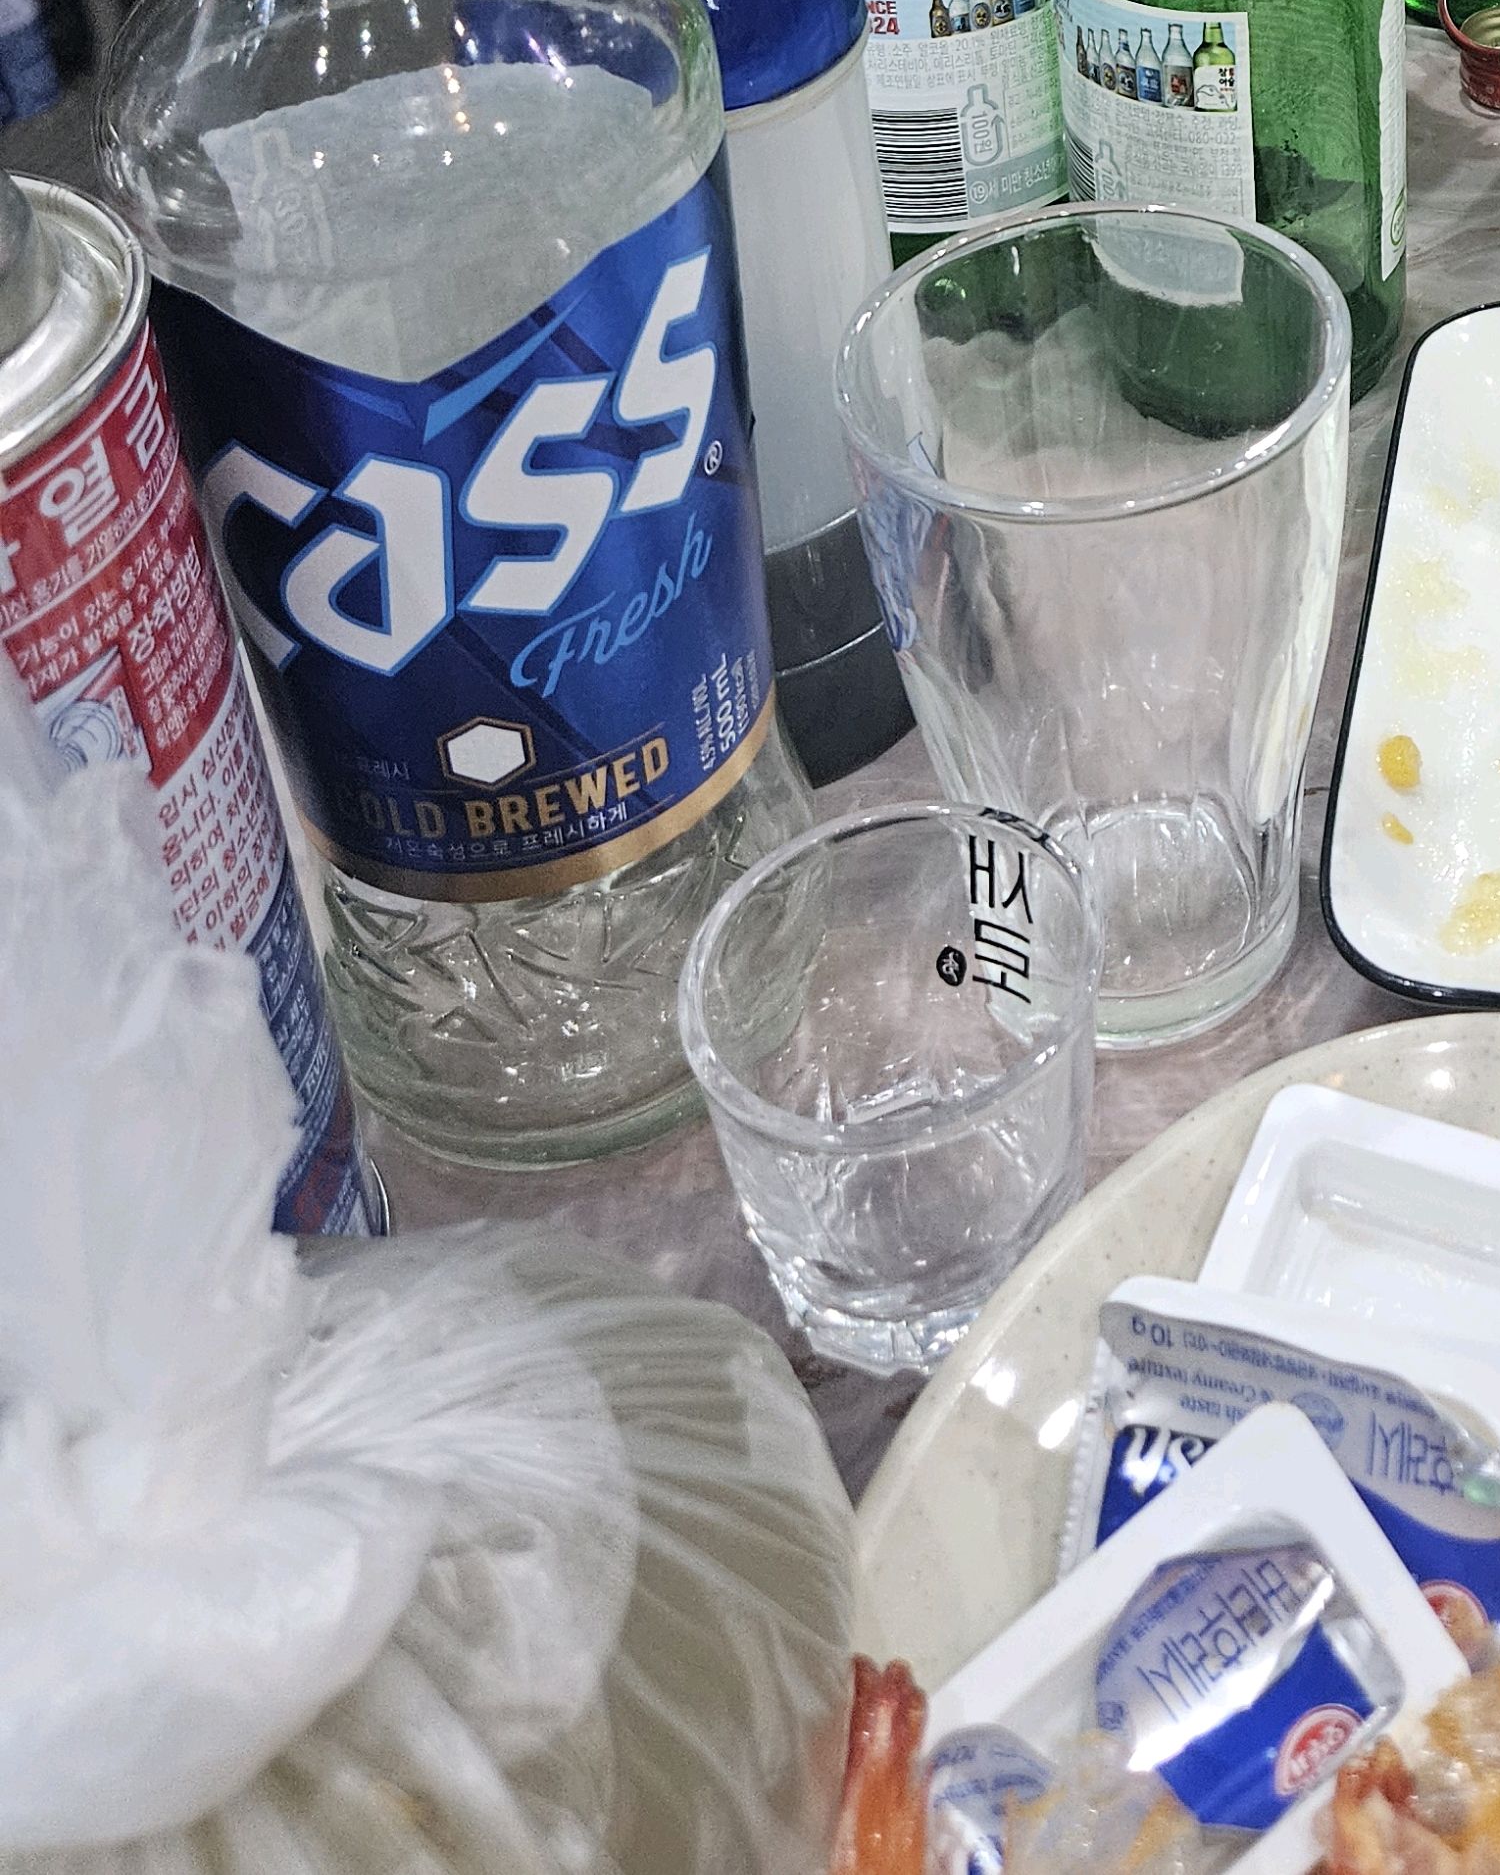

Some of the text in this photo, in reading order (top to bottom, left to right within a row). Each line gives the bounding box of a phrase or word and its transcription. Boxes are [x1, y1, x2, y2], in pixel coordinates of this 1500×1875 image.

[867, 0, 898, 15] NCE
[869, 16, 901, 35] 24
[127, 532, 203, 664] 장착방법
[509, 509, 714, 697] Fresh
[717, 699, 736, 753] 500
[342, 735, 672, 840] OLD BREWED
[521, 800, 629, 852] 프레시하게
